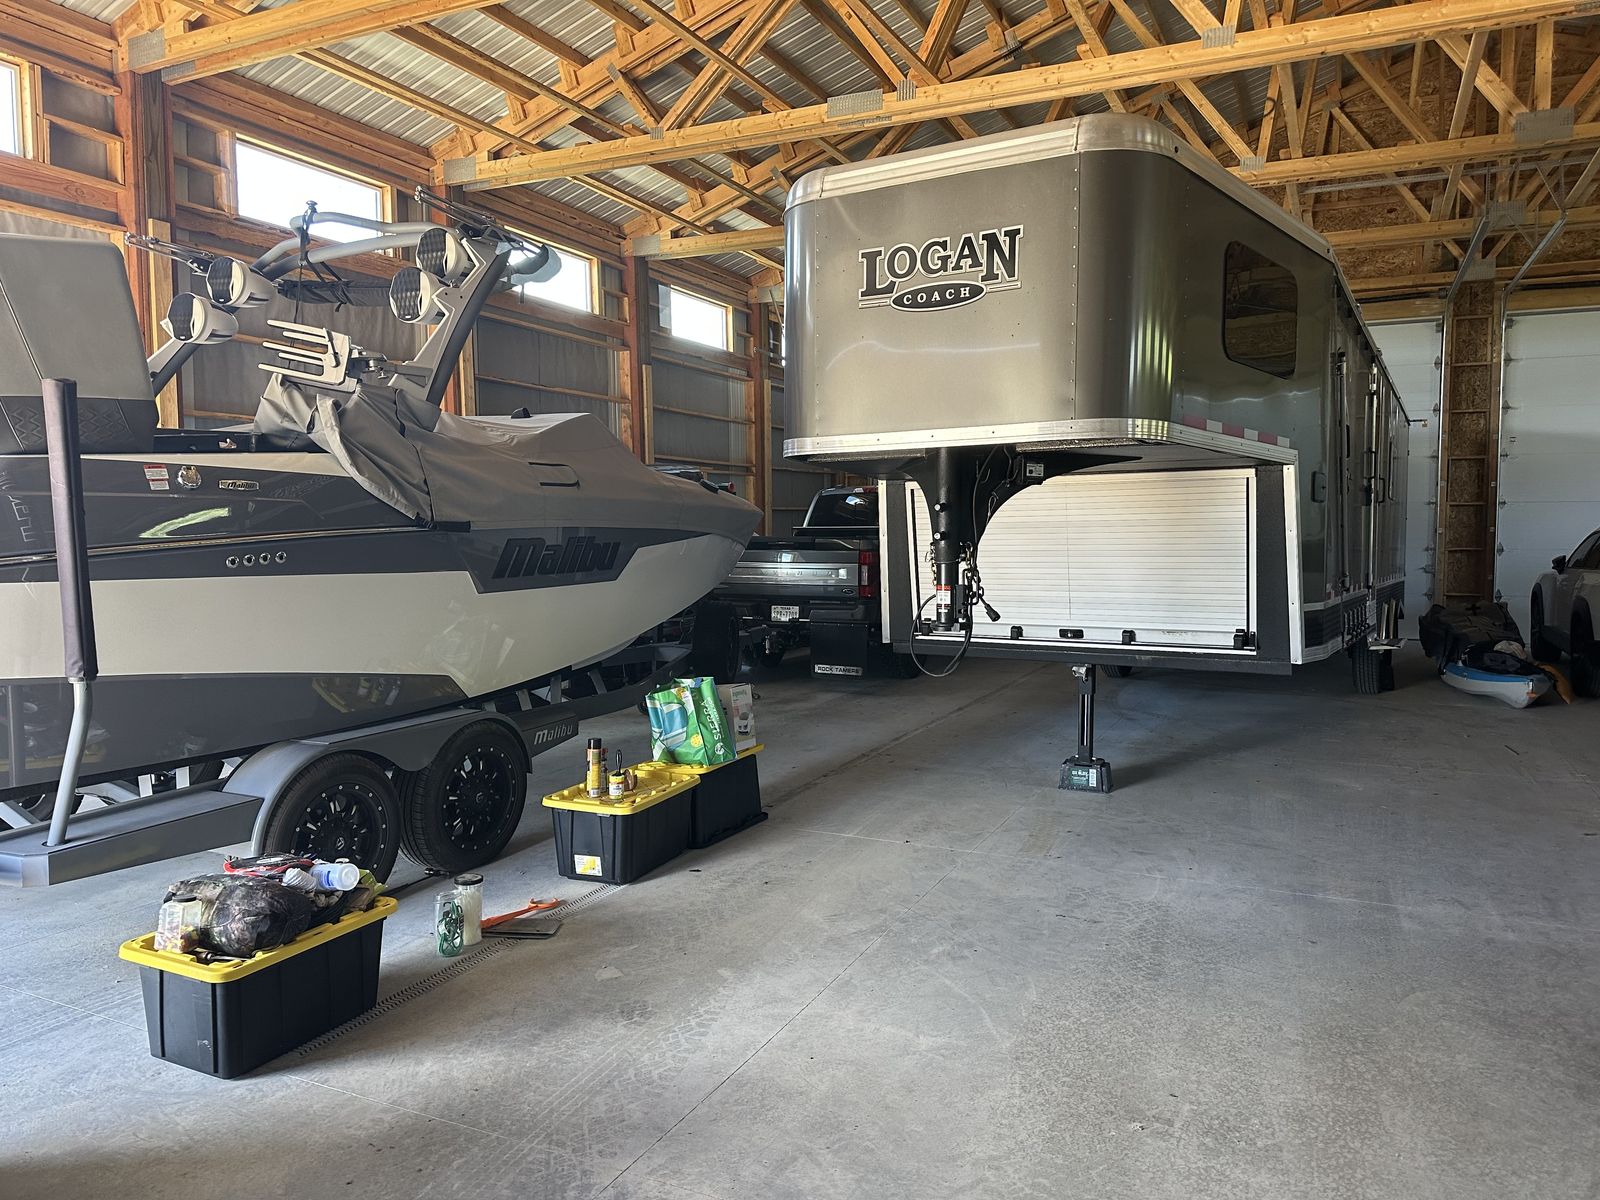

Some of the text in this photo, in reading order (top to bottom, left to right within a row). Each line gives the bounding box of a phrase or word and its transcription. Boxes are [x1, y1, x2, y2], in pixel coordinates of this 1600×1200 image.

[859, 225, 1023, 299] LOGAN
[903, 287, 971, 305] COACH
[491, 536, 622, 579] Malibu
[817, 665, 834, 673] ROCK
[534, 723, 573, 745] Malibu
[700, 699, 722, 741] SIERRA
